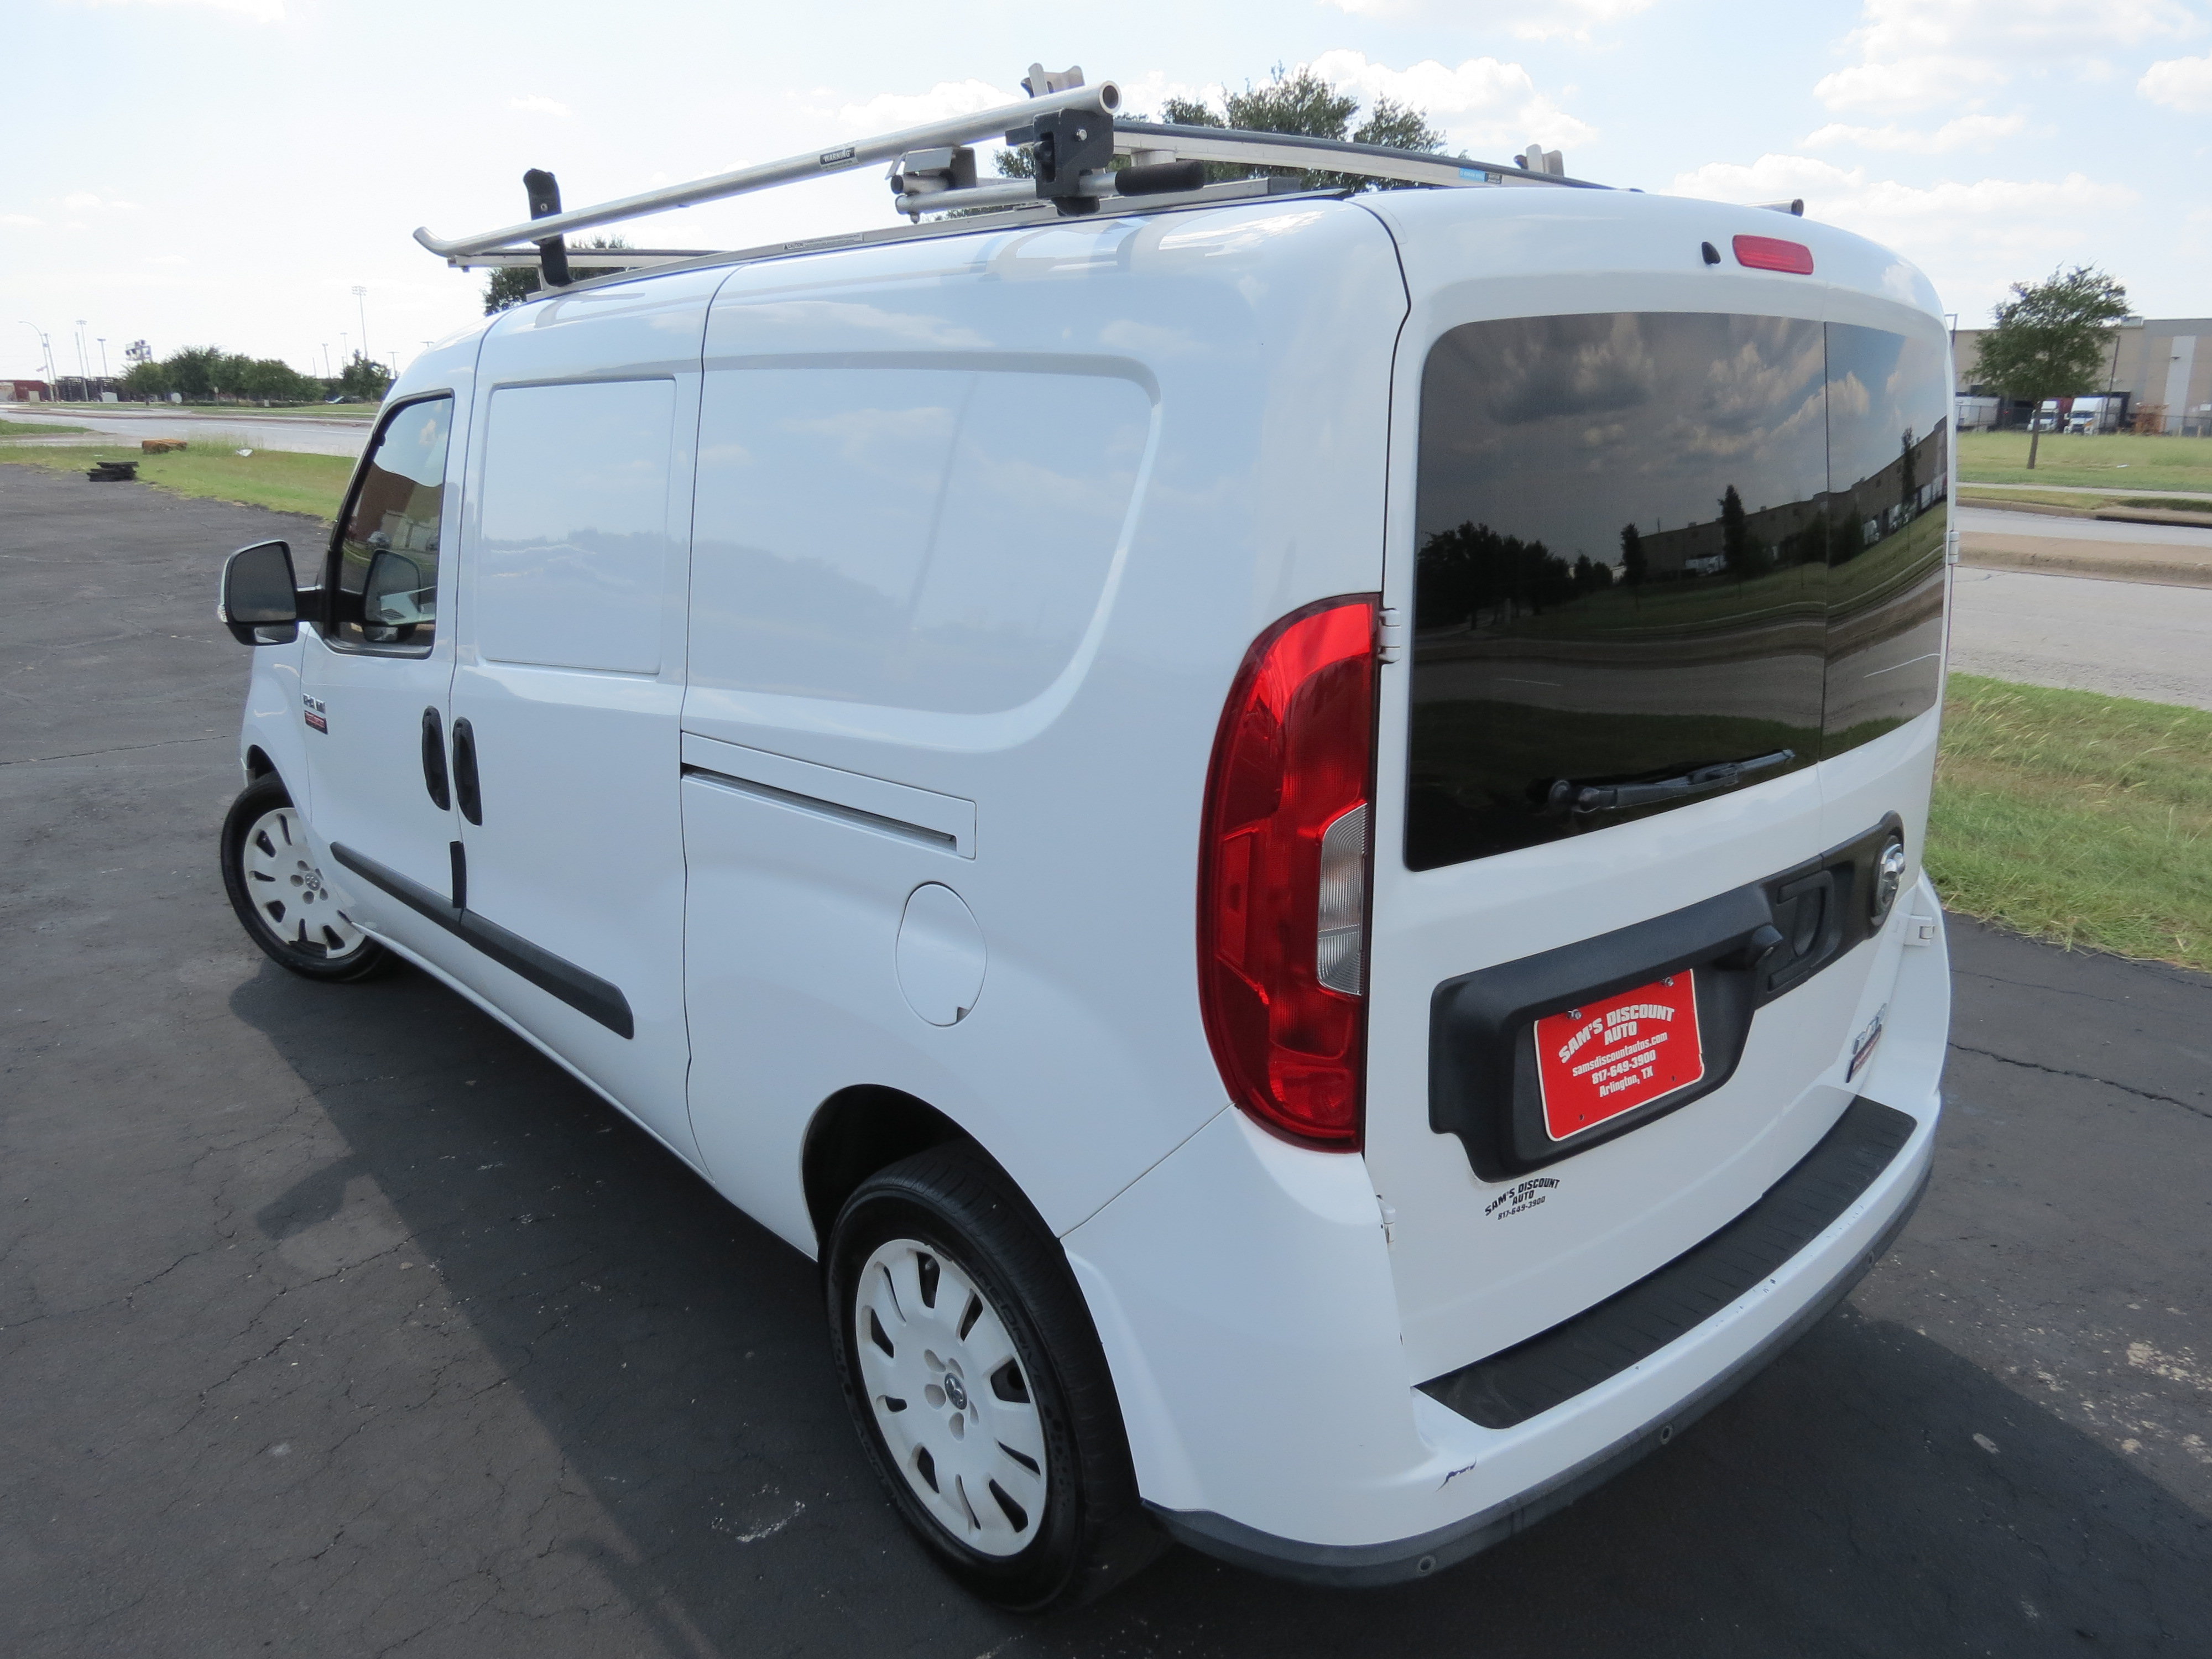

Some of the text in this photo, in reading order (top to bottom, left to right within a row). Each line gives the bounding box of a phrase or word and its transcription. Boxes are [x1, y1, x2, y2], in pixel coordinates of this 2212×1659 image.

[825, 149, 851, 162] WARNING
[1559, 1004, 1674, 1063] SAM'S DISCOUNT
[1604, 1021, 1637, 1045] AUTO
[1572, 1032, 1668, 1076] samsdiscountautos.com
[1592, 1050, 1656, 1084] 817-649-3900
[1599, 1066, 1653, 1098] Arlington, TX
[1485, 1178, 1560, 1216] SAM'S DISCOUNT
[1497, 1196, 1546, 1220] 817-649-3900
[1512, 1190, 1535, 1206] AUTO
